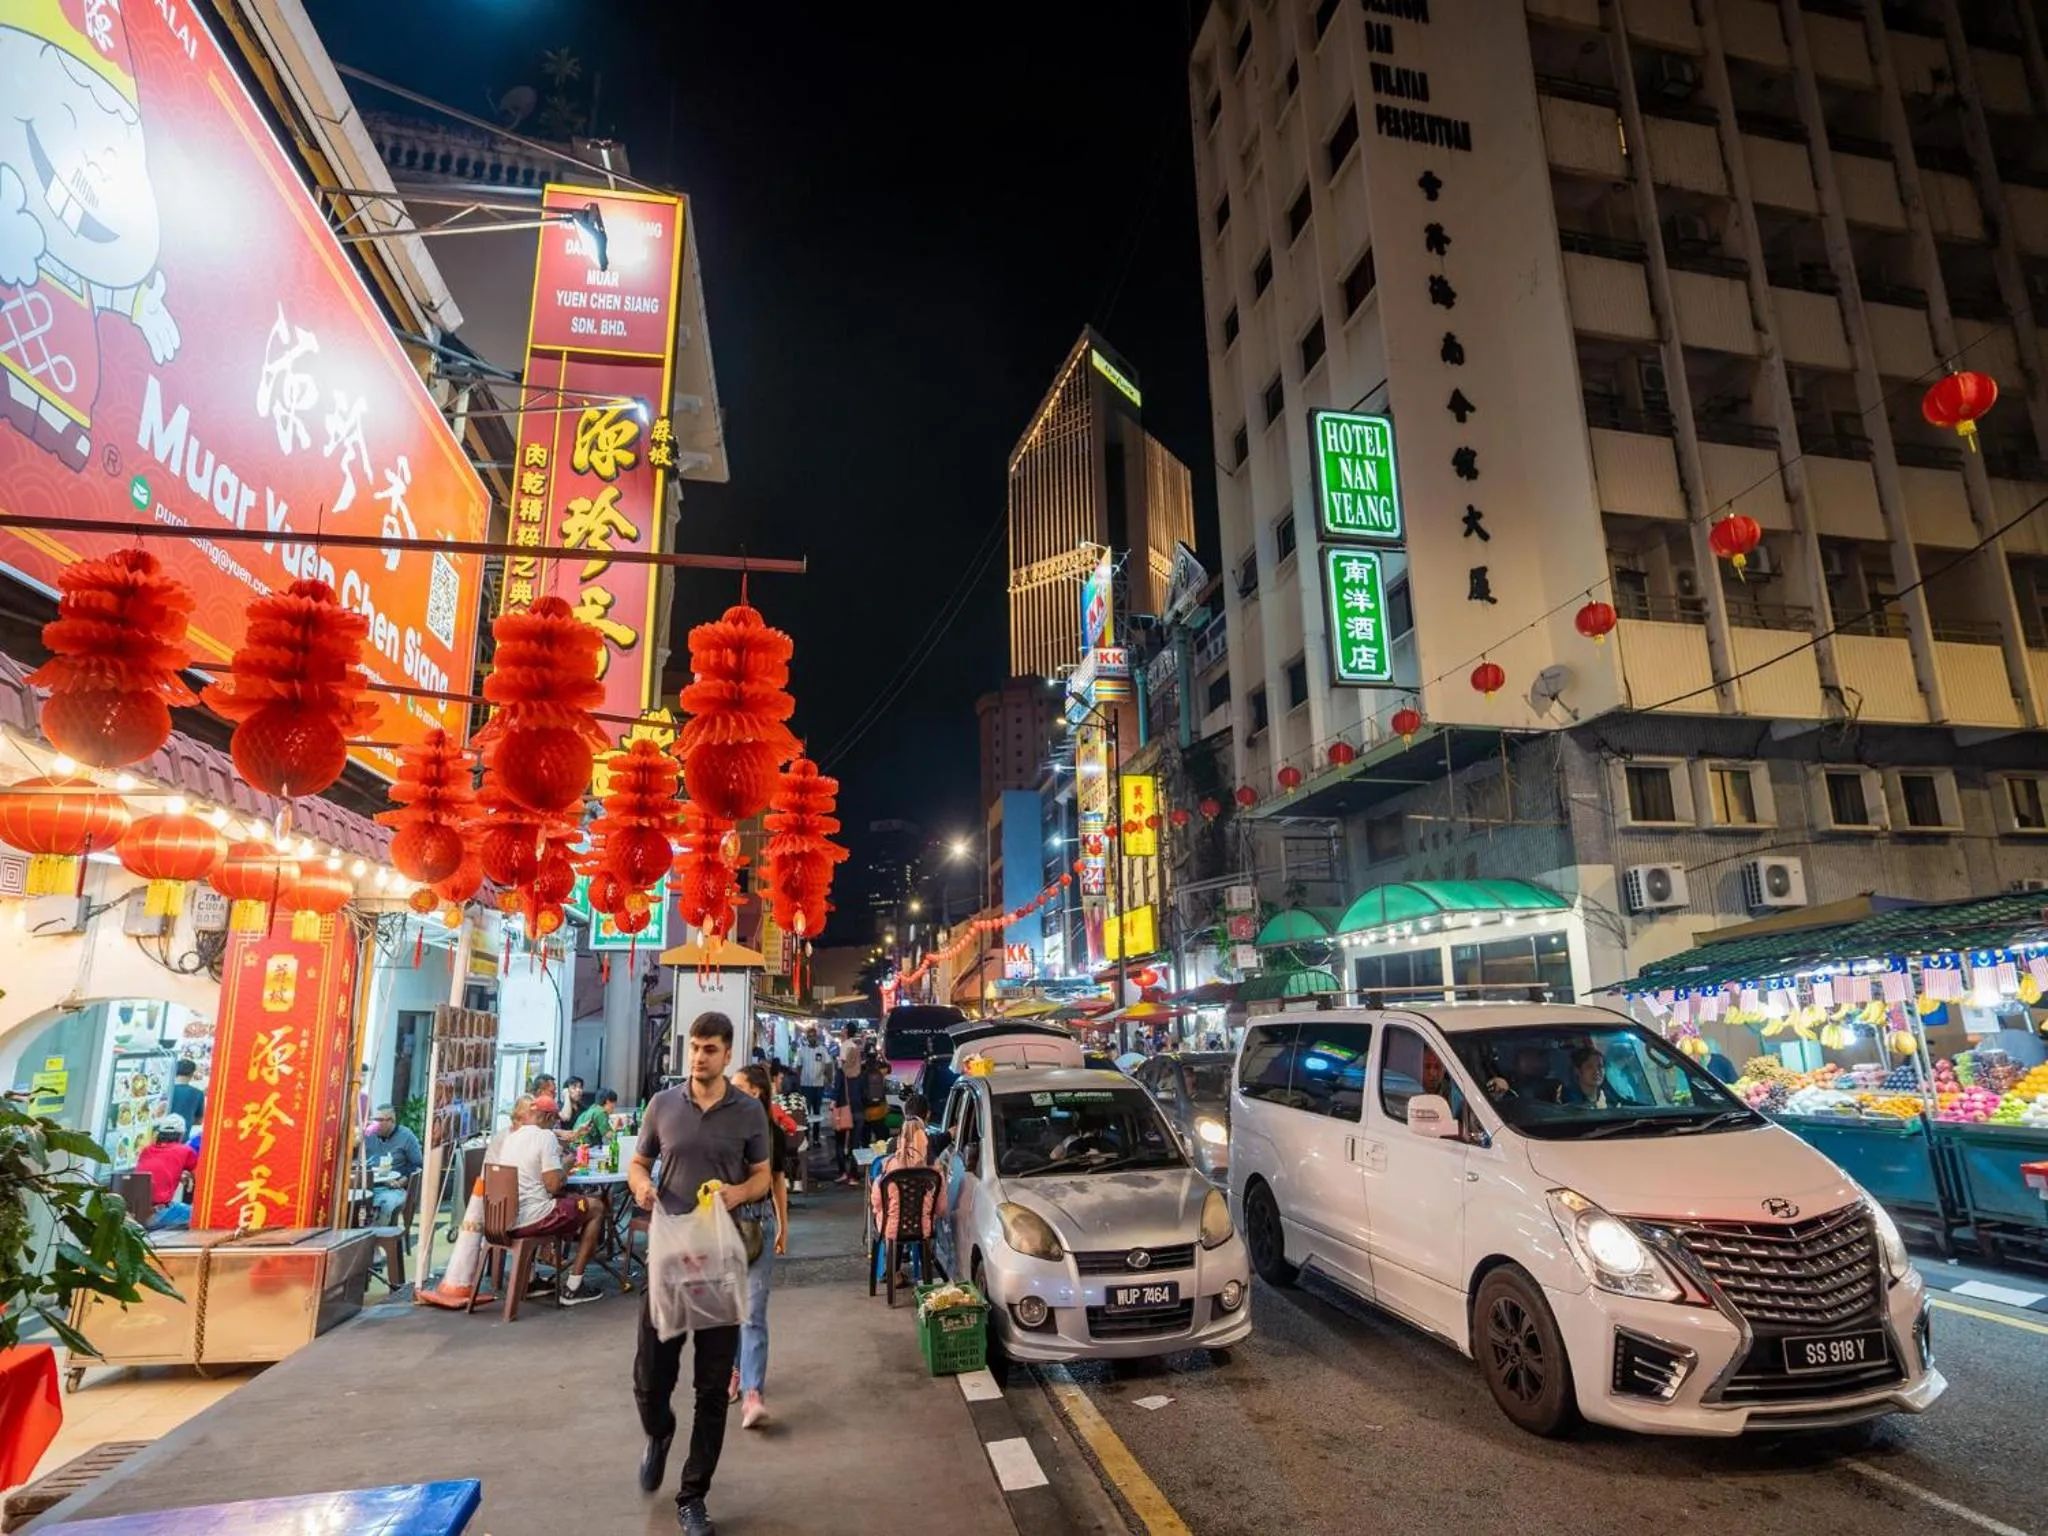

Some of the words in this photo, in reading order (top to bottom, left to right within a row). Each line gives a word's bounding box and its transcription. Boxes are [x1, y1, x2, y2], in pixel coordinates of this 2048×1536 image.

[1370, 62, 1429, 102] WILAYAH
[1376, 103, 1472, 152] PERSEKUTUAN
[587, 270, 619, 287] MUAR
[556, 290, 587, 308] YUEN
[590, 292, 621, 311] CHEN
[623, 295, 659, 314] SIANG
[571, 317, 597, 334] SDN.
[600, 319, 627, 336] BHD.
[1324, 421, 1386, 458] HOTEL
[1340, 457, 1378, 492] NAN
[1331, 491, 1393, 528] YEANG
[137, 373, 257, 531] Muar
[262, 485, 336, 589] Yuen
[341, 568, 399, 665] Chen
[403, 625, 449, 714] Siang
[507, 442, 548, 618] 肉乾精粹之典
[1340, 558, 1379, 671] 南洋酒店
[1100, 652, 1123, 664] KK
[226, 1025, 295, 1236] 源珍香
[1116, 1288, 1140, 1305] WUP
[1142, 1286, 1169, 1304] 7464
[1806, 1342, 1827, 1364] SS
[1830, 1339, 1855, 1362] 918
[1857, 1338, 1865, 1360] Y
